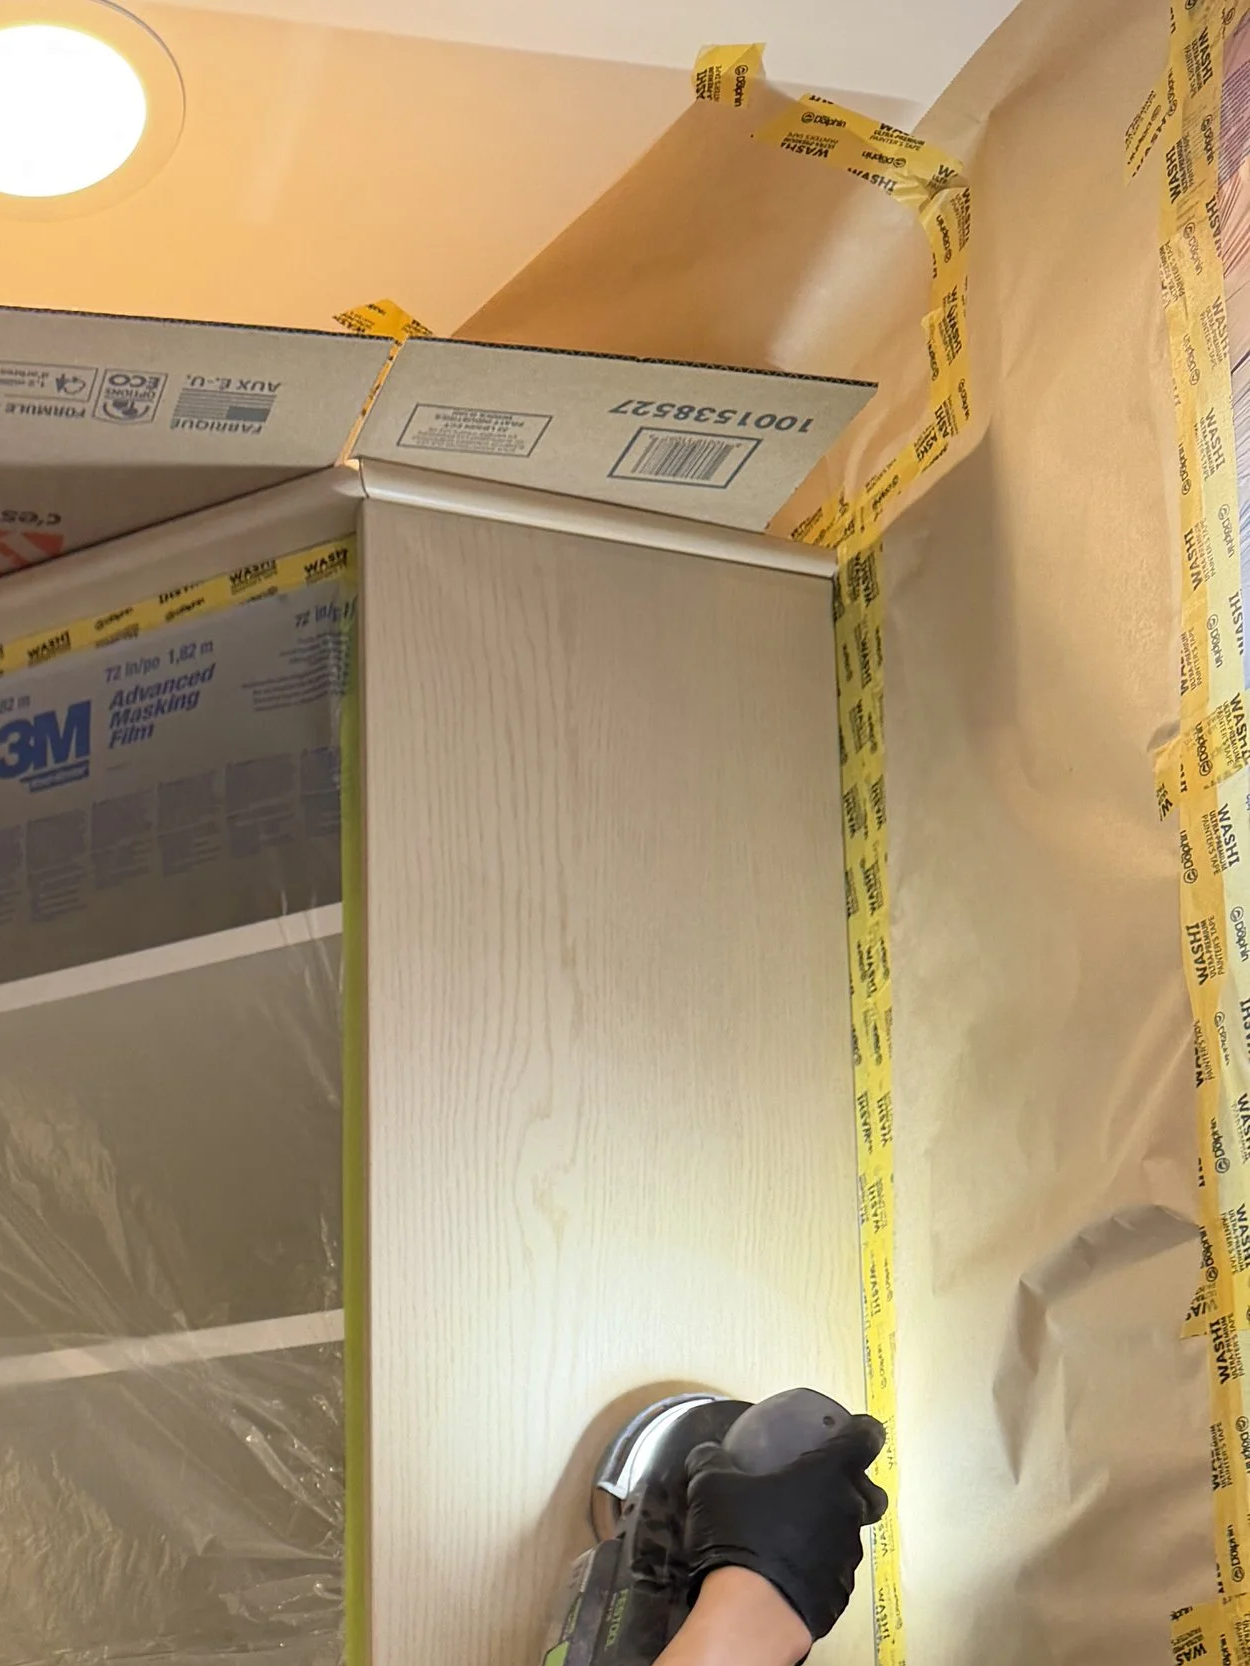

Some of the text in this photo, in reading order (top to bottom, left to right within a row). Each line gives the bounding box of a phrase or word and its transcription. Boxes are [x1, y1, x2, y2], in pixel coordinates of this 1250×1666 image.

[1198, 26, 1213, 85] WASHI
[813, 113, 846, 128] Dolphin
[1165, 144, 1181, 205] WASHI
[105, 388, 157, 398] OPTIONS
[236, 379, 281, 393] AUX
[5, 403, 86, 418] FORMULE
[609, 399, 815, 434] 1001538527
[1205, 408, 1226, 471] WASHI
[1221, 518, 1235, 558] Dolphin
[1184, 528, 1202, 590] WASHI
[27, 631, 71, 659] WASHI
[104, 665, 122, 683] 72
[167, 645, 197, 668] 1,82
[1210, 628, 1224, 669] Dolphin
[108, 664, 216, 711] Advanced
[109, 688, 201, 730] Masking
[108, 724, 156, 750] Film
[1196, 722, 1209, 761] Dolphin
[1180, 830, 1193, 867] Dolphin
[1201, 814, 1221, 876] PAINTER'S TAPE
[1209, 809, 1228, 872] ULTRA-PREMIUM
[1217, 803, 1240, 868] WASHI
[1186, 923, 1208, 985] WASHI
[1233, 921, 1248, 961] Dolphin
[1209, 1321, 1230, 1385] WASHI
